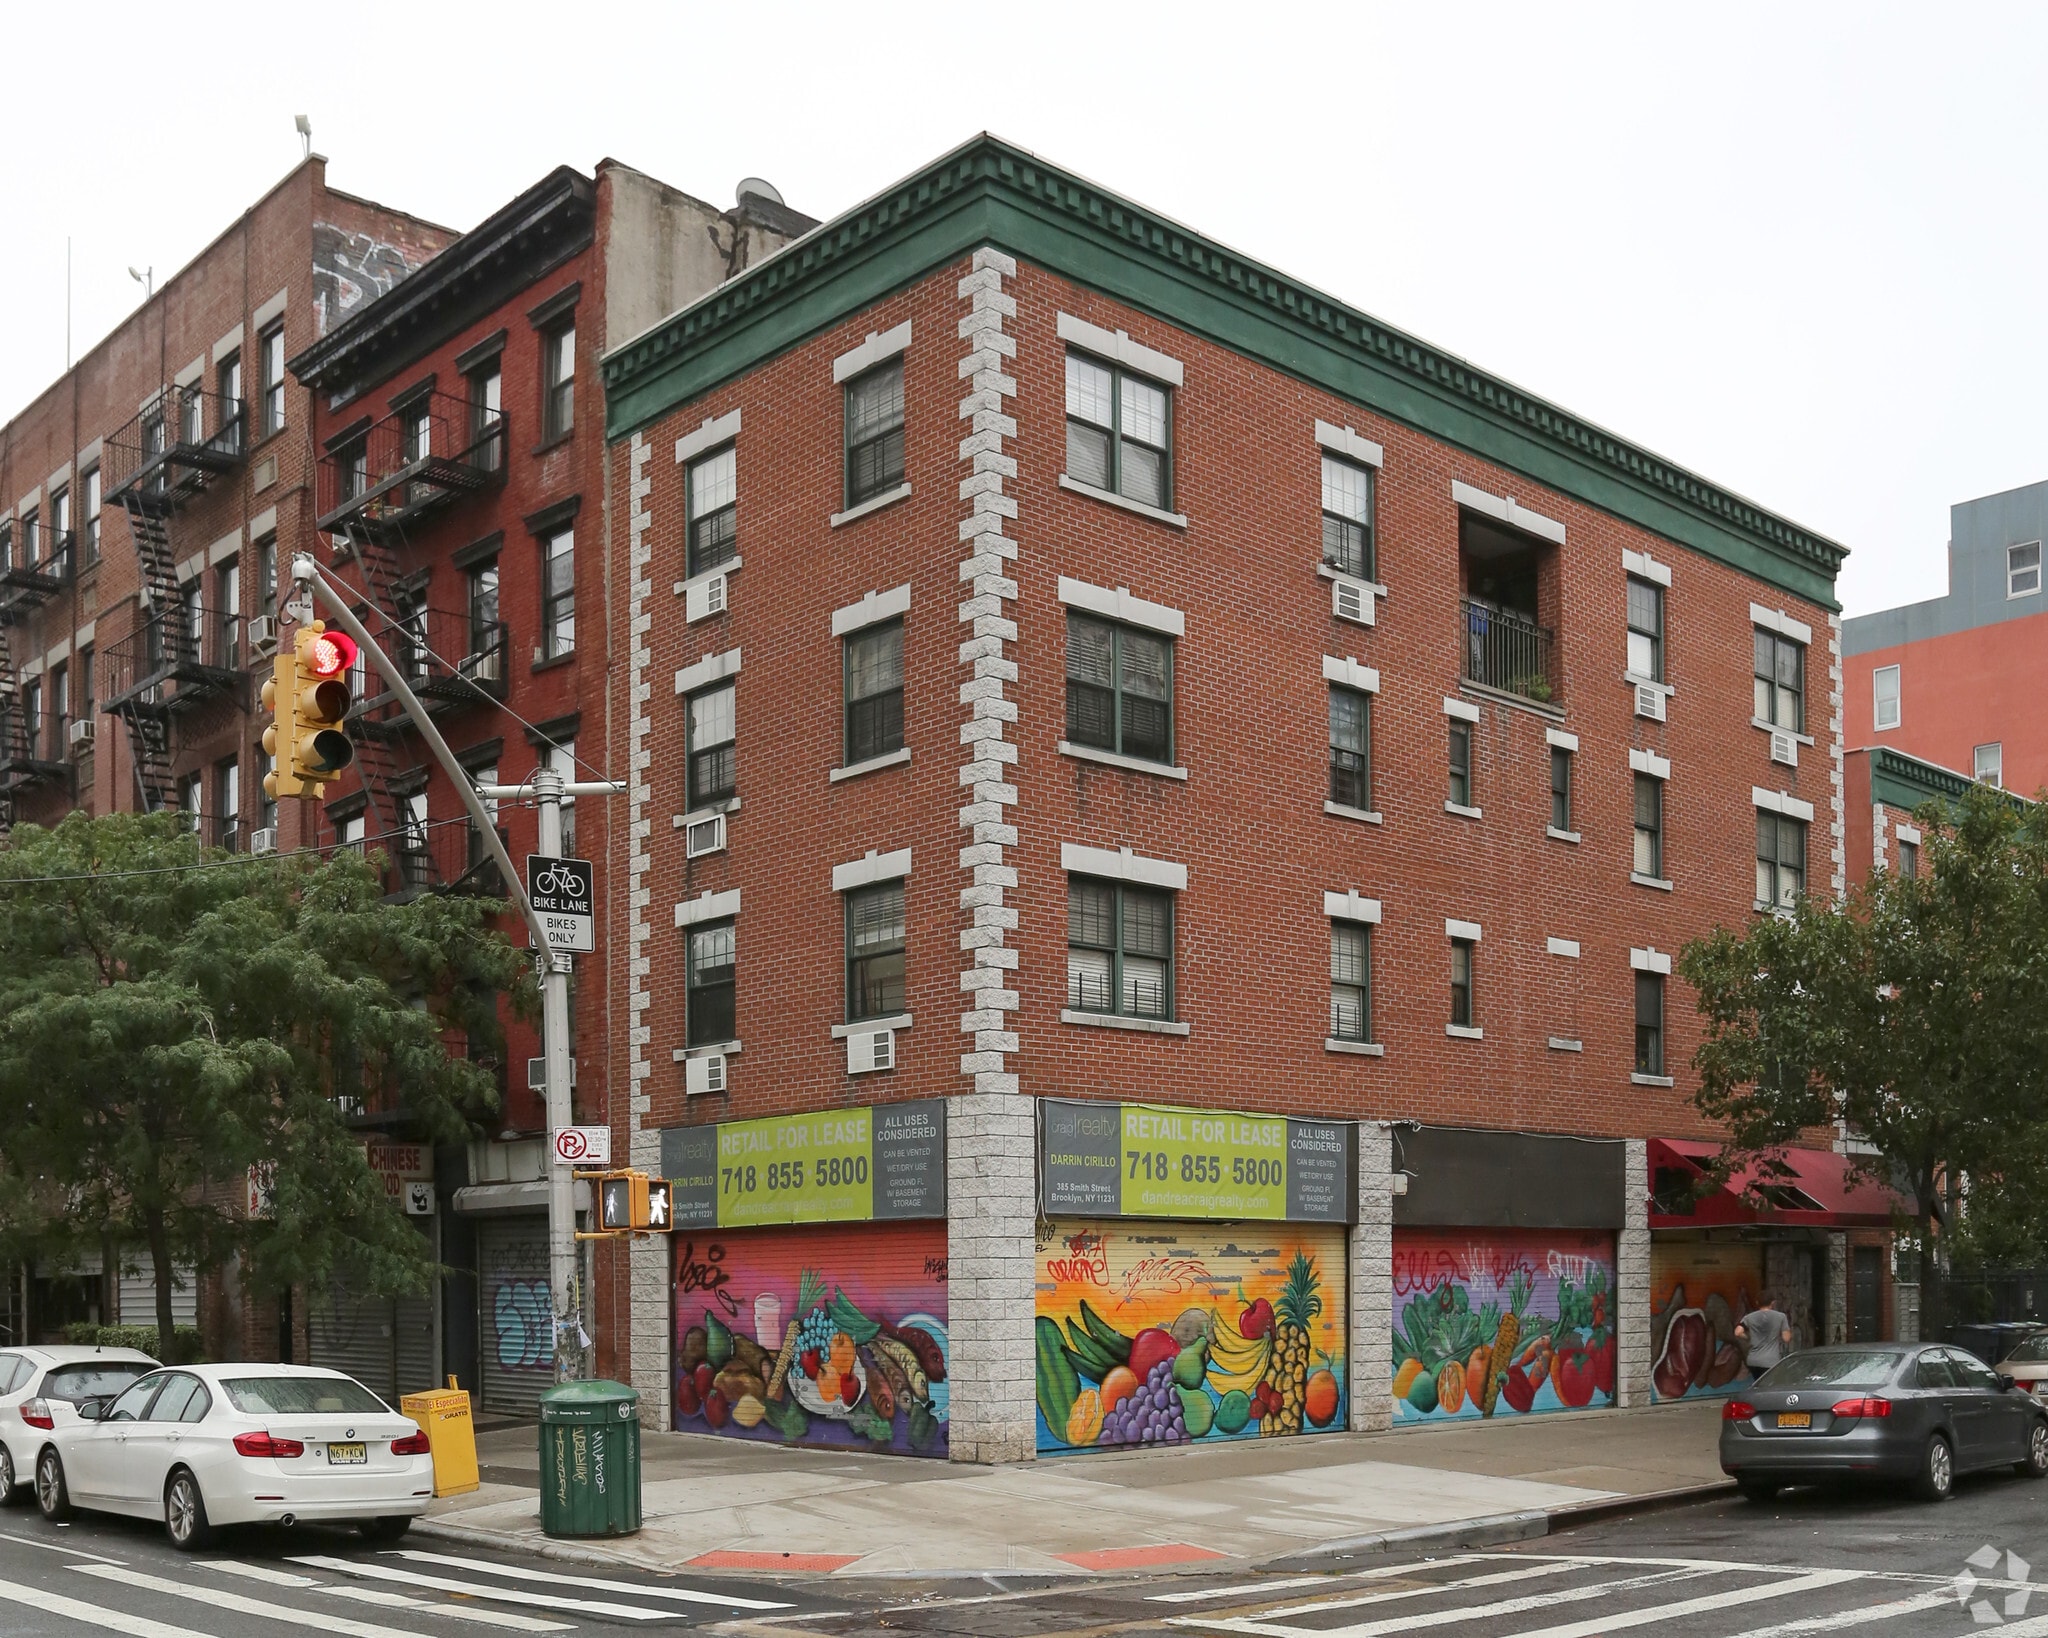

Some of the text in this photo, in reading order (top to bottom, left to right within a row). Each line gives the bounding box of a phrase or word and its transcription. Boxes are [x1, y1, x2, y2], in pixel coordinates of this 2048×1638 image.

[533, 896, 588, 912] BIKE LANE
[547, 917, 576, 930] BIKES
[548, 931, 575, 944] ONLY
[885, 1113, 929, 1128] ALL USES
[878, 1126, 937, 1141] CONSIDERED
[1077, 1114, 1116, 1141] realty
[1126, 1114, 1282, 1147] RETAIL FOR LEASE
[1298, 1127, 1336, 1140] ALL USES
[722, 1119, 867, 1155] RETAIL FOR LEASE
[1291, 1139, 1342, 1152] CONSIDERED
[883, 1147, 931, 1158] CAN BE VENTED
[371, 1147, 421, 1171] CHINESE
[1050, 1153, 1116, 1168] DARRIN CIRILLO
[1296, 1158, 1308, 1166] CAN
[1316, 1159, 1337, 1168] VENTED
[915, 1162, 928, 1171] USE
[1126, 1151, 1283, 1187] 718 855 5800
[689, 1175, 714, 1187] CIRILLO
[722, 1156, 868, 1194] 718 855 5800
[1323, 1173, 1334, 1181] USE
[380, 1172, 400, 1196] OD
[889, 1178, 916, 1187] GROUND
[1056, 1182, 1111, 1193] 385 Smith Street
[1301, 1184, 1324, 1193] GROUND
[895, 1188, 928, 1197] BASEMENT
[1051, 1193, 1115, 1203] Brooklyn, NY 11231
[1306, 1194, 1335, 1203] BASEMENT
[679, 1202, 694, 1210] Smith
[694, 1201, 710, 1209] Street
[893, 1199, 921, 1208] STORAGE
[1304, 1203, 1329, 1212] STORAGE
[444, 1410, 468, 1420] GRATIS
